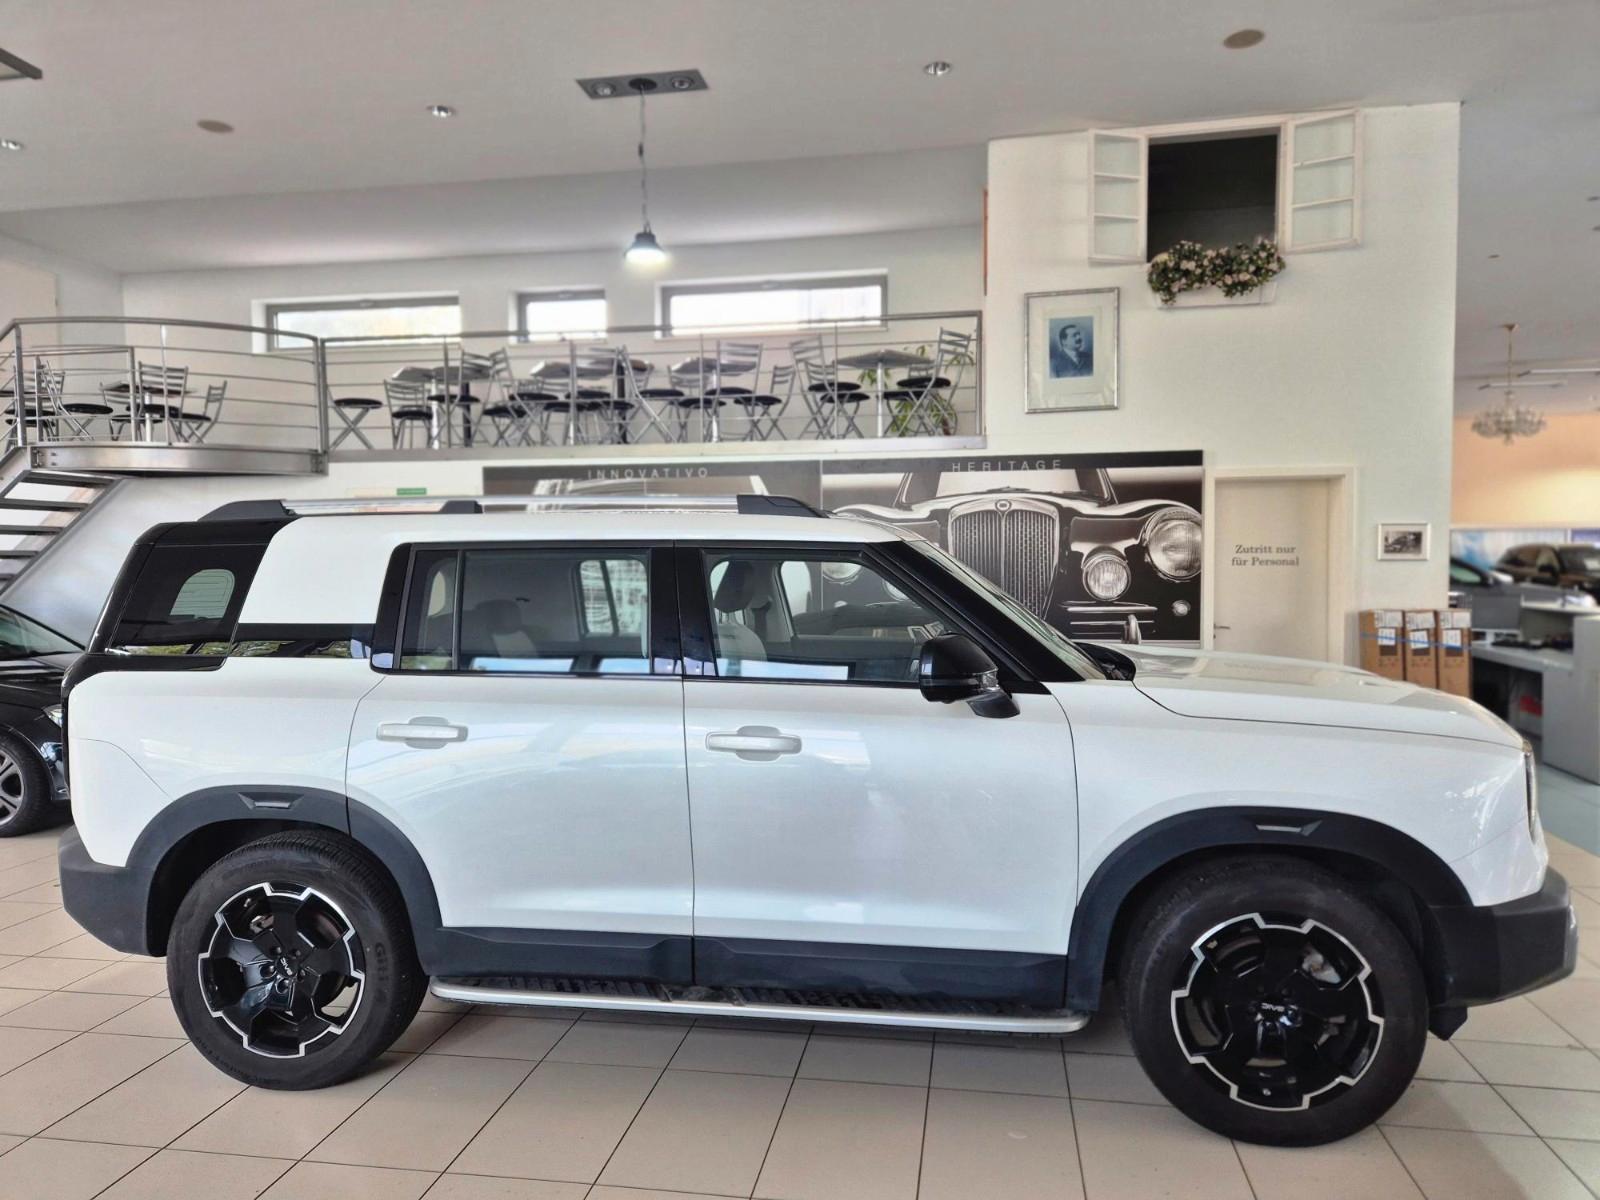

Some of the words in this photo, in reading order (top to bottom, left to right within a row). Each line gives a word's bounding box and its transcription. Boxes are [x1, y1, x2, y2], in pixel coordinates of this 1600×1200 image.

[951, 459, 1062, 473] HERITAGE
[587, 467, 708, 480] INNOVATIVO
[1235, 544, 1272, 554] Zutritt
[1276, 546, 1297, 554] nur
[1231, 556, 1249, 566] für
[1251, 556, 1300, 567] Personal
